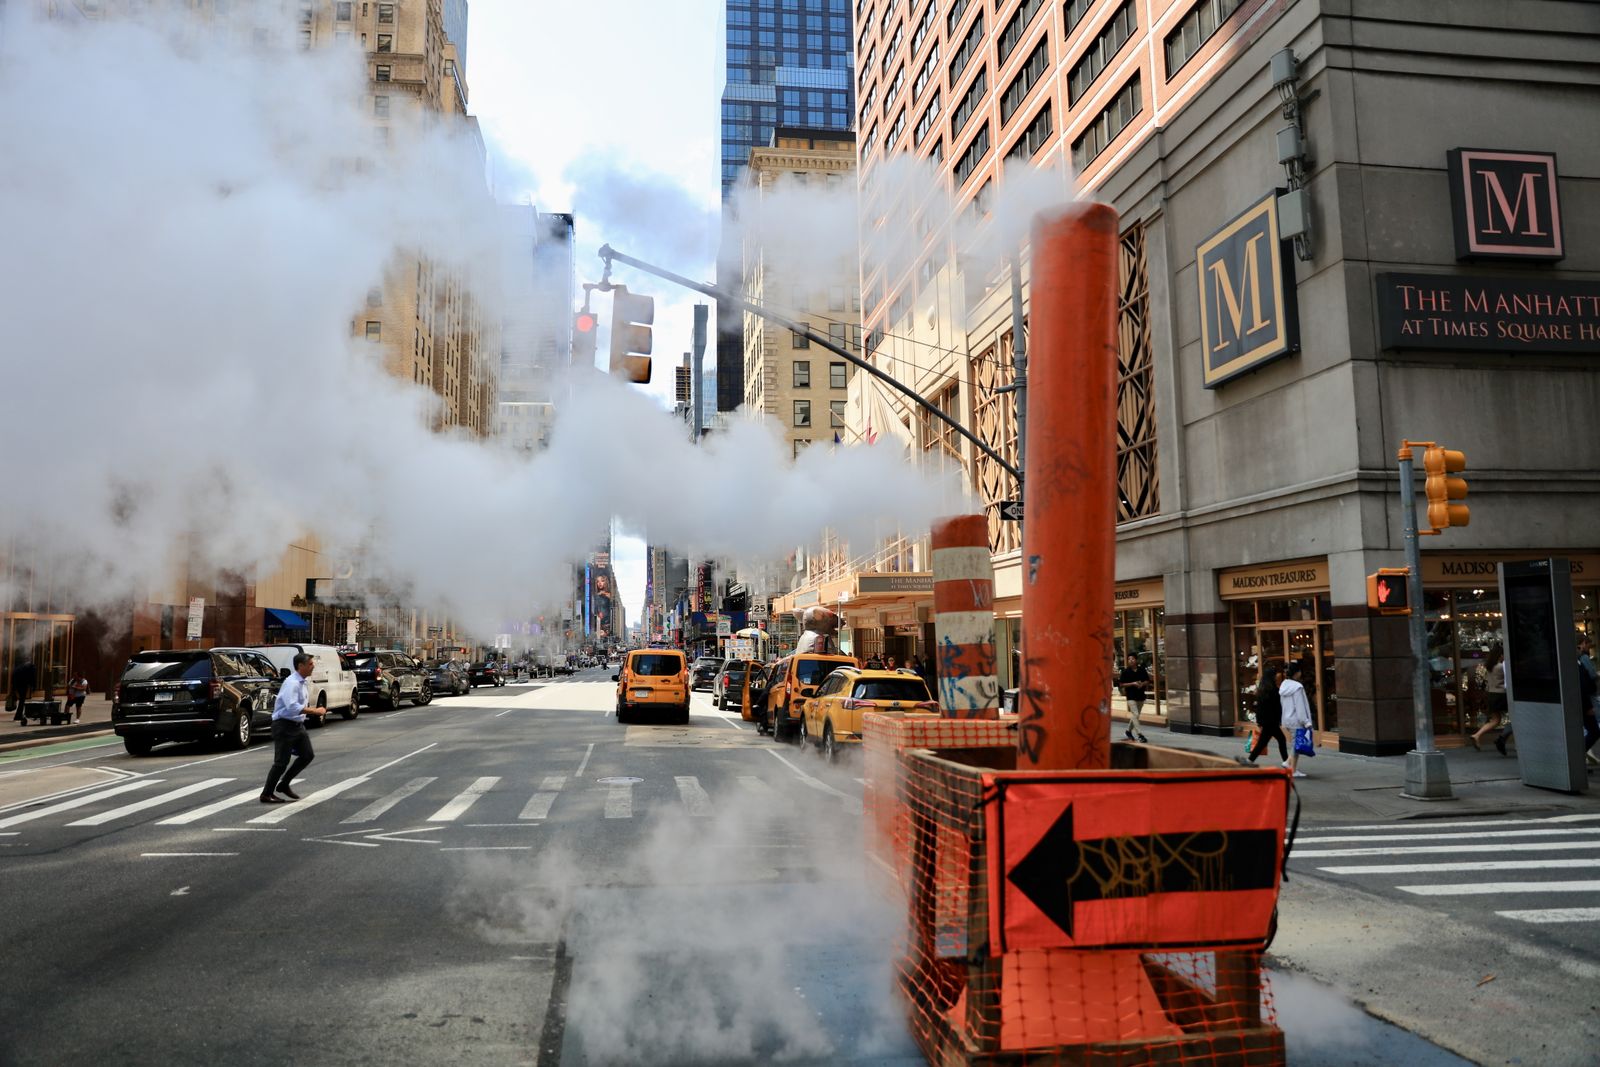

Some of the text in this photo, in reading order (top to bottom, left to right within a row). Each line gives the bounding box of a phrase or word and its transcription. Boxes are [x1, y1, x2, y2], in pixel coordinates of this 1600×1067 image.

[1476, 170, 1548, 236] M
[1208, 231, 1271, 353] M
[1396, 285, 1600, 317] THE MANHATT
[1401, 319, 1424, 335] AT
[1428, 317, 1489, 337] TIMES
[1497, 320, 1573, 343] SQUARE
[1232, 568, 1316, 589] MADISON TREASURES
[1442, 561, 1498, 575] MADISO
[754, 604, 766, 613] 25
